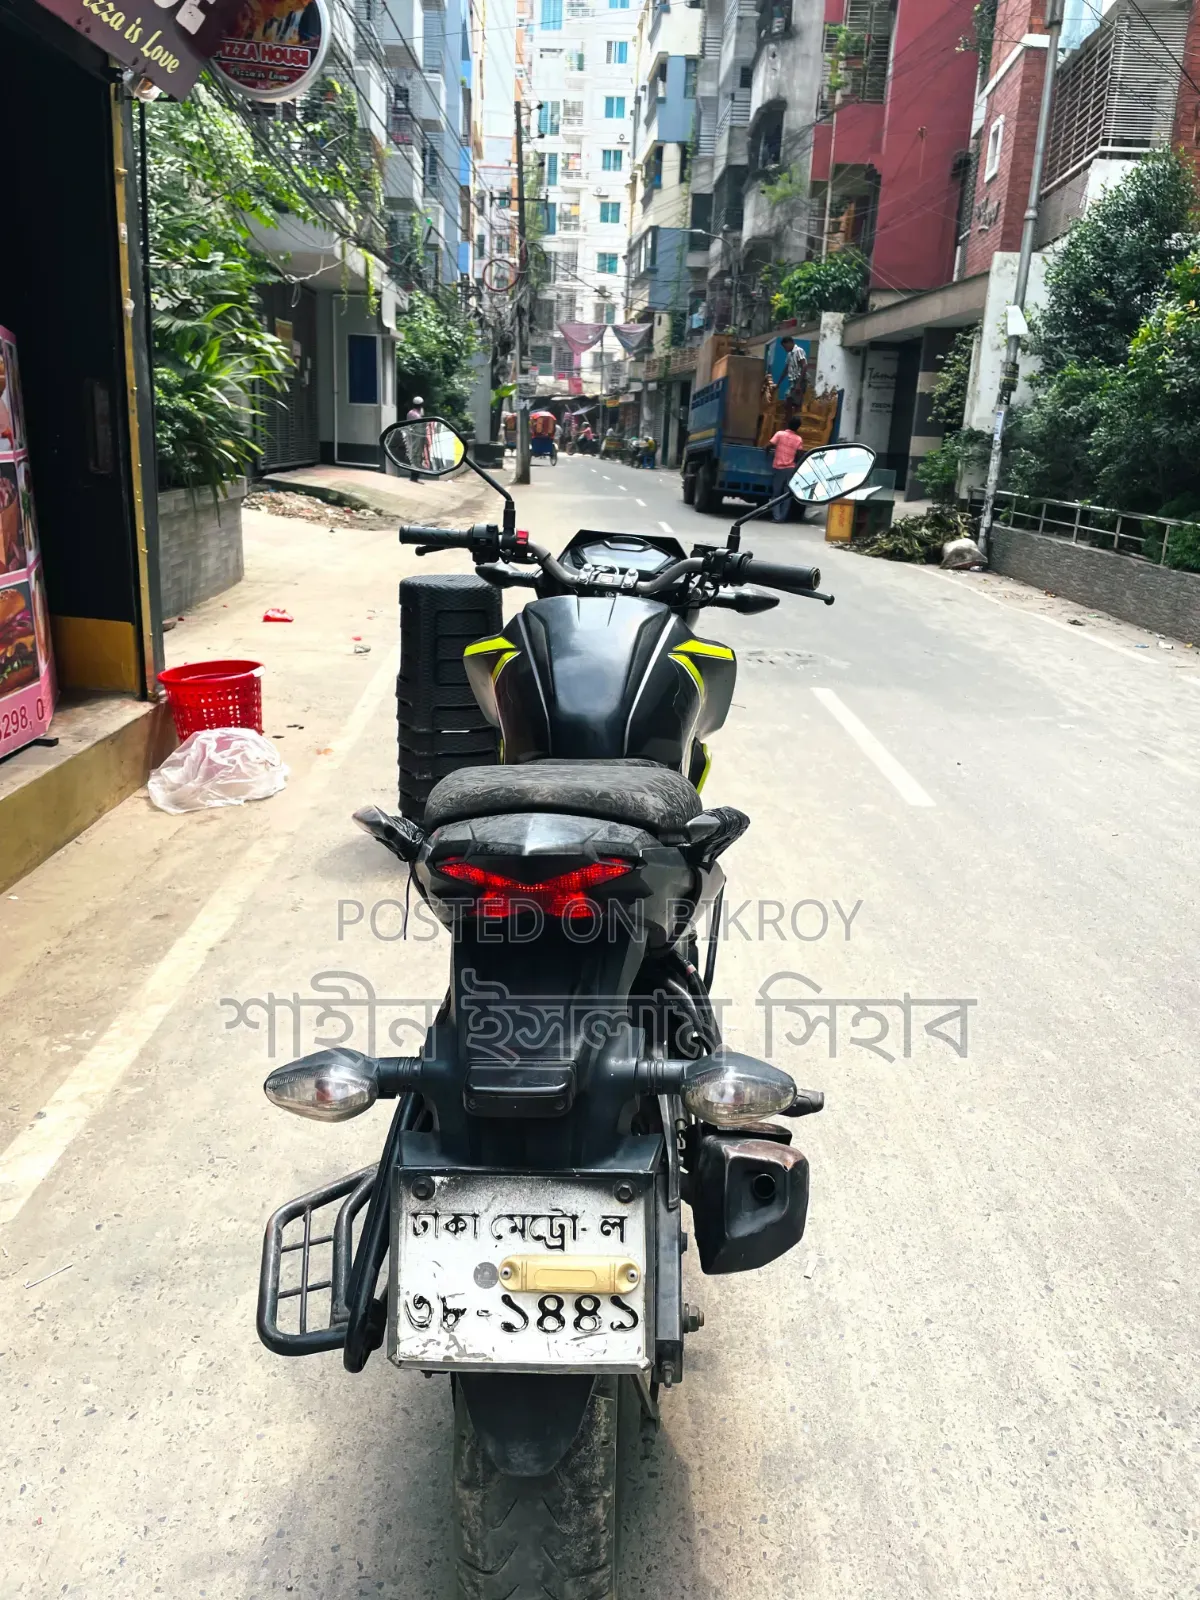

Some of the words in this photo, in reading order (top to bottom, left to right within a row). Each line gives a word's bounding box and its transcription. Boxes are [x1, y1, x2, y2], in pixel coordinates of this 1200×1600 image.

[124, 17, 143, 44] is
[140, 30, 180, 74] Love
[0, 705, 33, 740] 298,
[410, 1209, 480, 1241] ঢাকা
